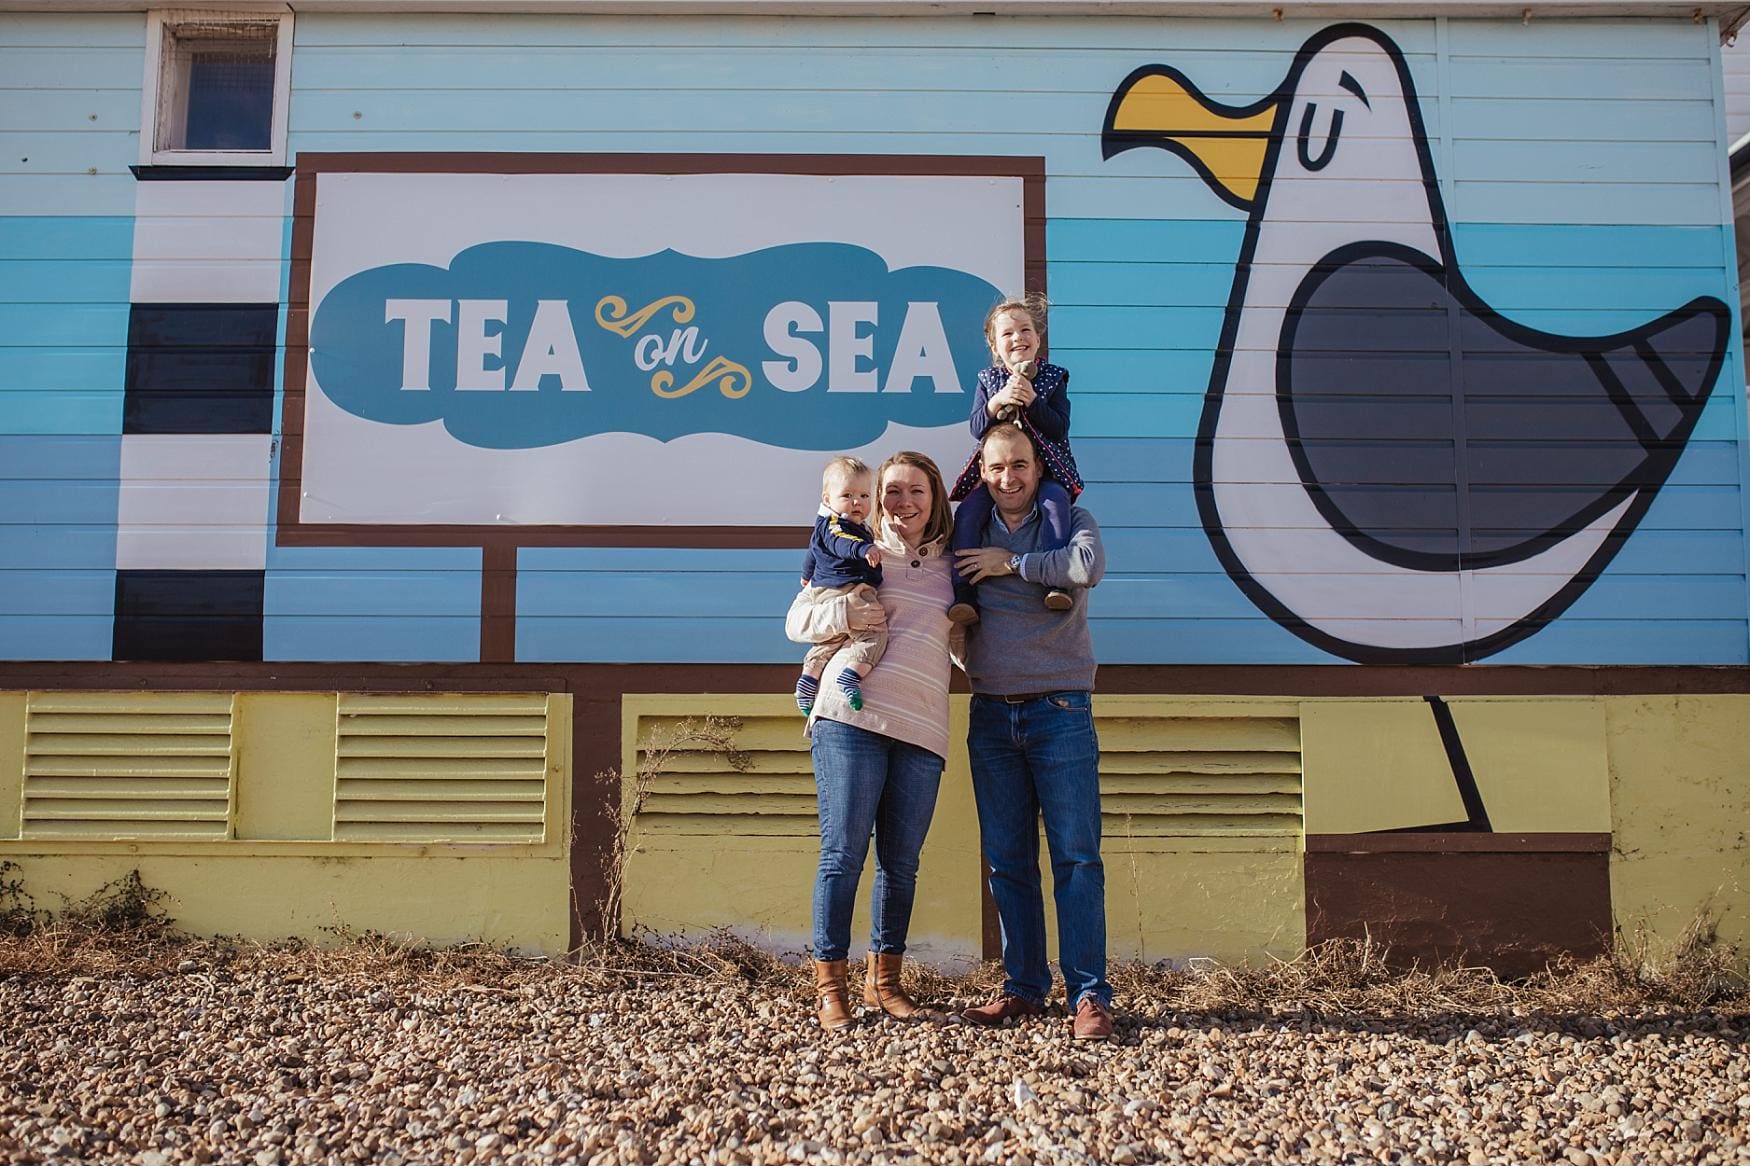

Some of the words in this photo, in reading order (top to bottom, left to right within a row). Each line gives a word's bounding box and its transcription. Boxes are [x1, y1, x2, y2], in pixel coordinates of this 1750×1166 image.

[384, 299, 592, 392] TEA
[633, 322, 710, 373] on
[761, 301, 964, 393] SEA
